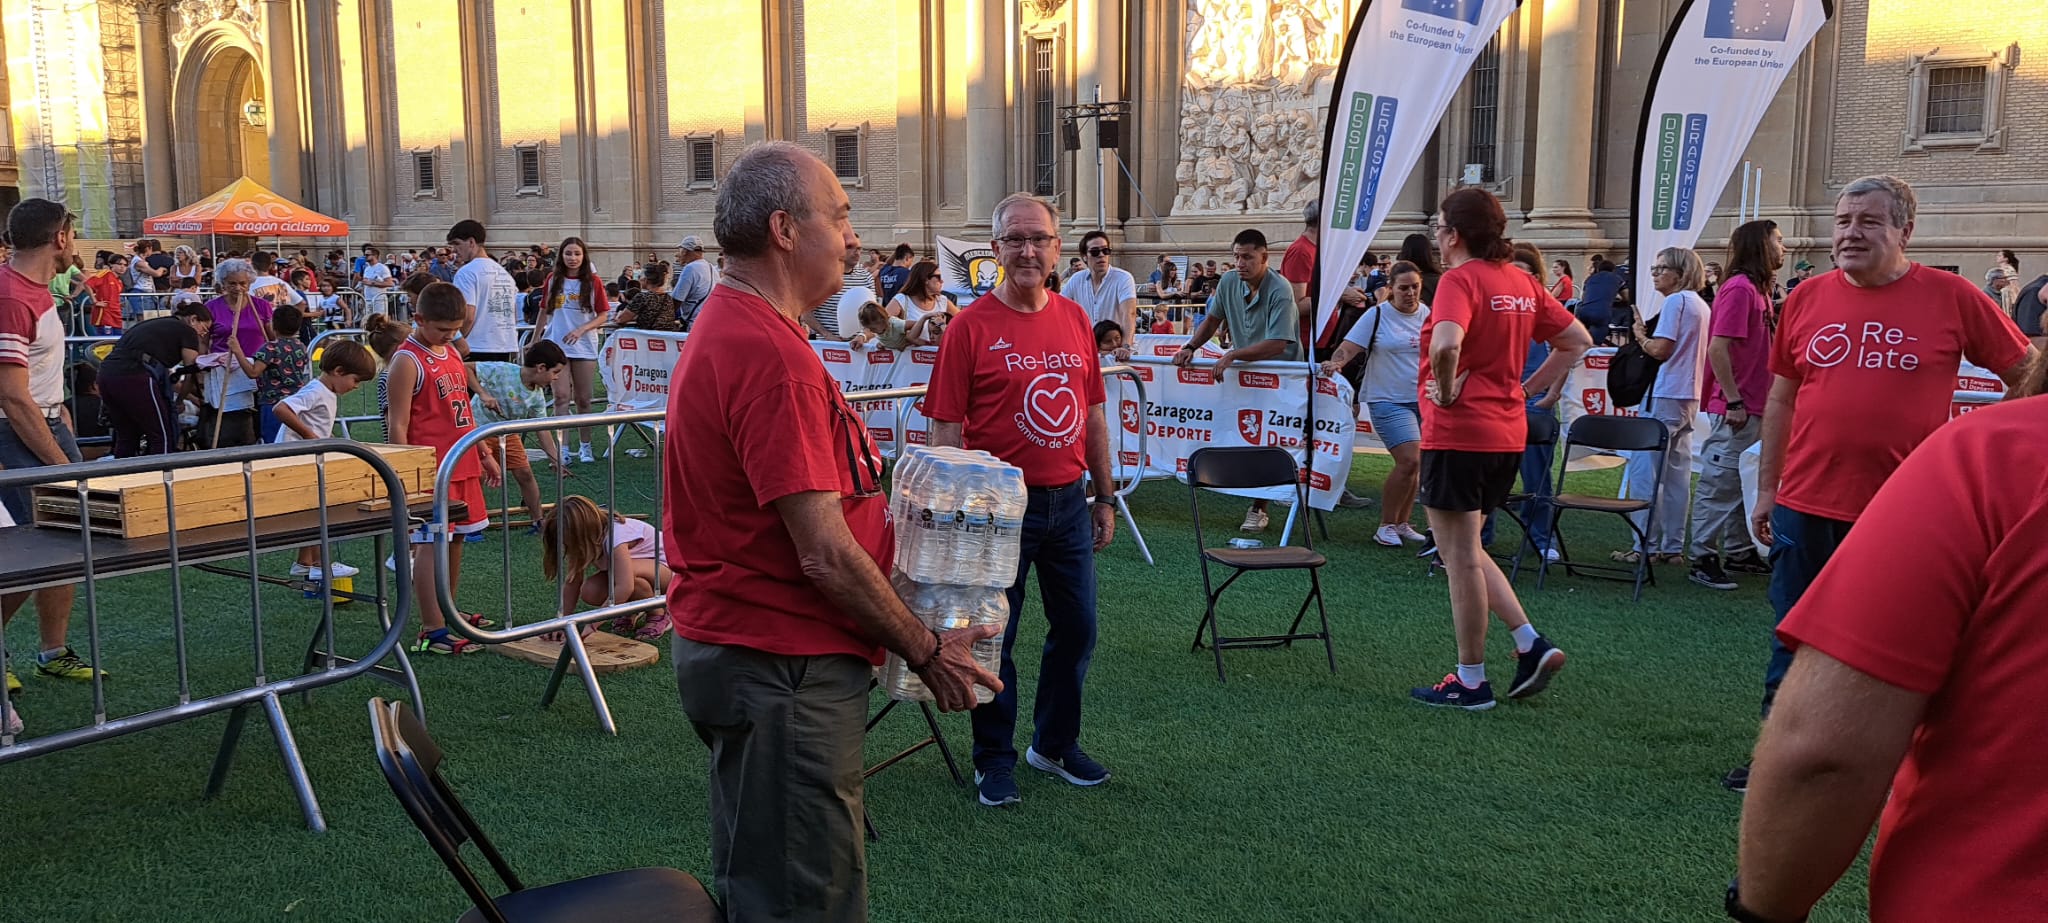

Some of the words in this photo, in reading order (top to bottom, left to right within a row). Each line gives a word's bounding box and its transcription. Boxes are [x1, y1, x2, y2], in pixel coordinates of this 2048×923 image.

[1406, 20, 1454, 37] Co-funded
[1389, 29, 1404, 40] the
[1407, 33, 1451, 50] European
[1694, 57, 1710, 65] the
[1712, 58, 1758, 68] European
[1710, 46, 1760, 56] Co-funded
[1762, 49, 1773, 58] by
[1338, 97, 1366, 224] DSSTREET
[1656, 118, 1677, 226] DSSTREET
[1677, 118, 1702, 225] ERASMUS+
[280, 221, 330, 233] ciclismo
[1861, 321, 1919, 345] Re-
[1004, 351, 1083, 372] Re-late
[1857, 345, 1919, 371] late
[634, 365, 668, 381] Zaragoza
[435, 373, 468, 399] BULL
[1146, 402, 1213, 423] Zaragoza
[1268, 410, 1340, 434] Zaraoza
[1014, 412, 1046, 447] Camino
[1049, 438, 1062, 448] de
[1146, 421, 1212, 442] DEPORTE
